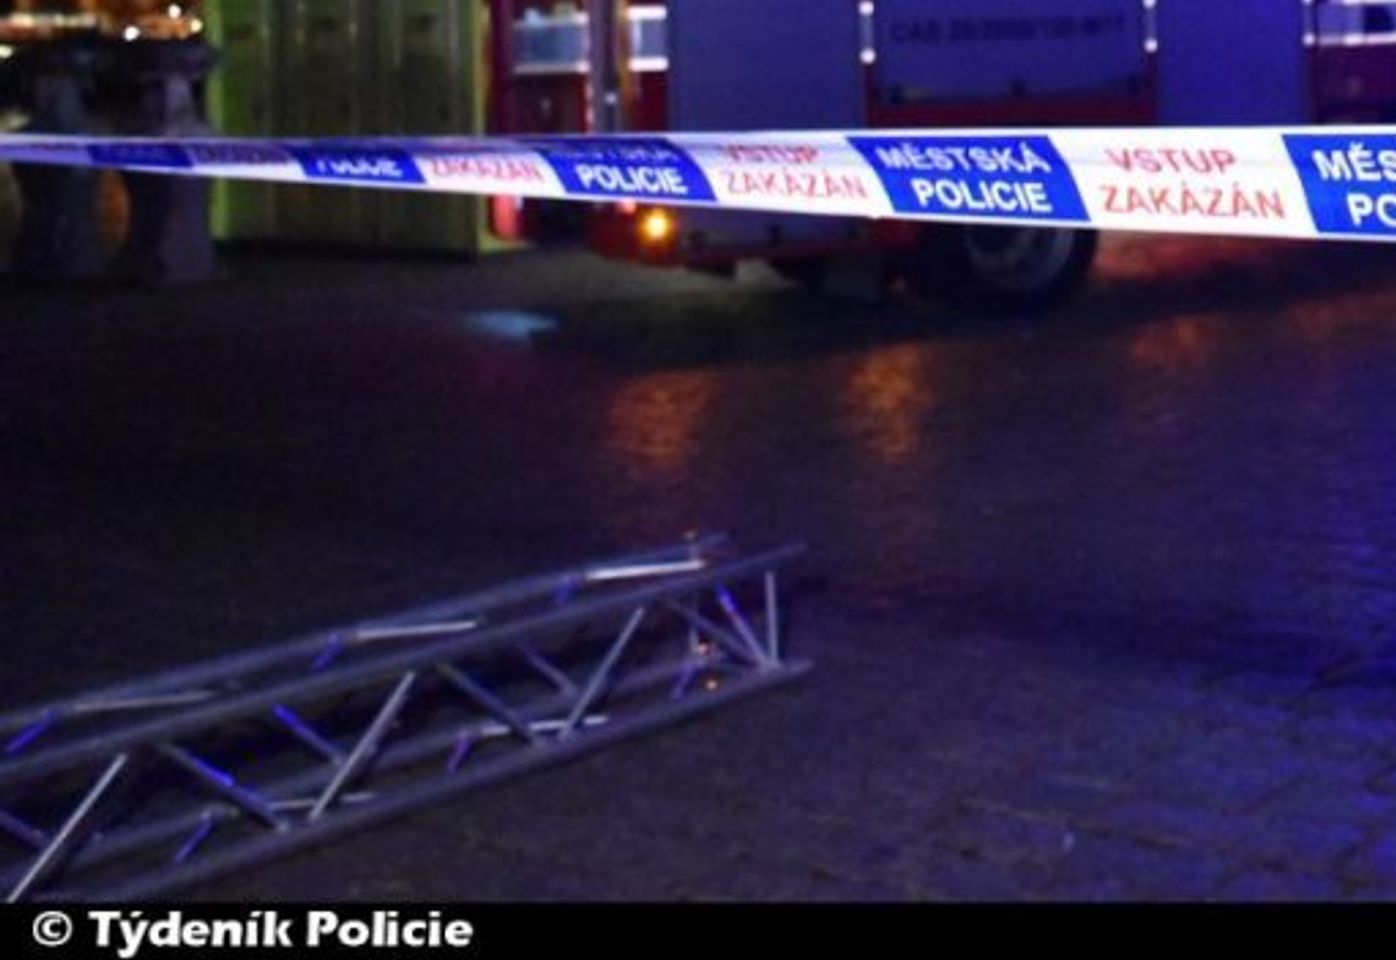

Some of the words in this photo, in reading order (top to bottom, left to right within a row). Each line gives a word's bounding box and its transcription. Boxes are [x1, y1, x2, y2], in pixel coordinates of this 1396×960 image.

[875, 141, 1051, 173] MĚSTSKÁ
[1105, 148, 1237, 173] VSTUP
[575, 163, 687, 195] POLICIE
[911, 178, 1052, 213] POLICIE
[1099, 180, 1285, 219] ZAKÁZÁN
